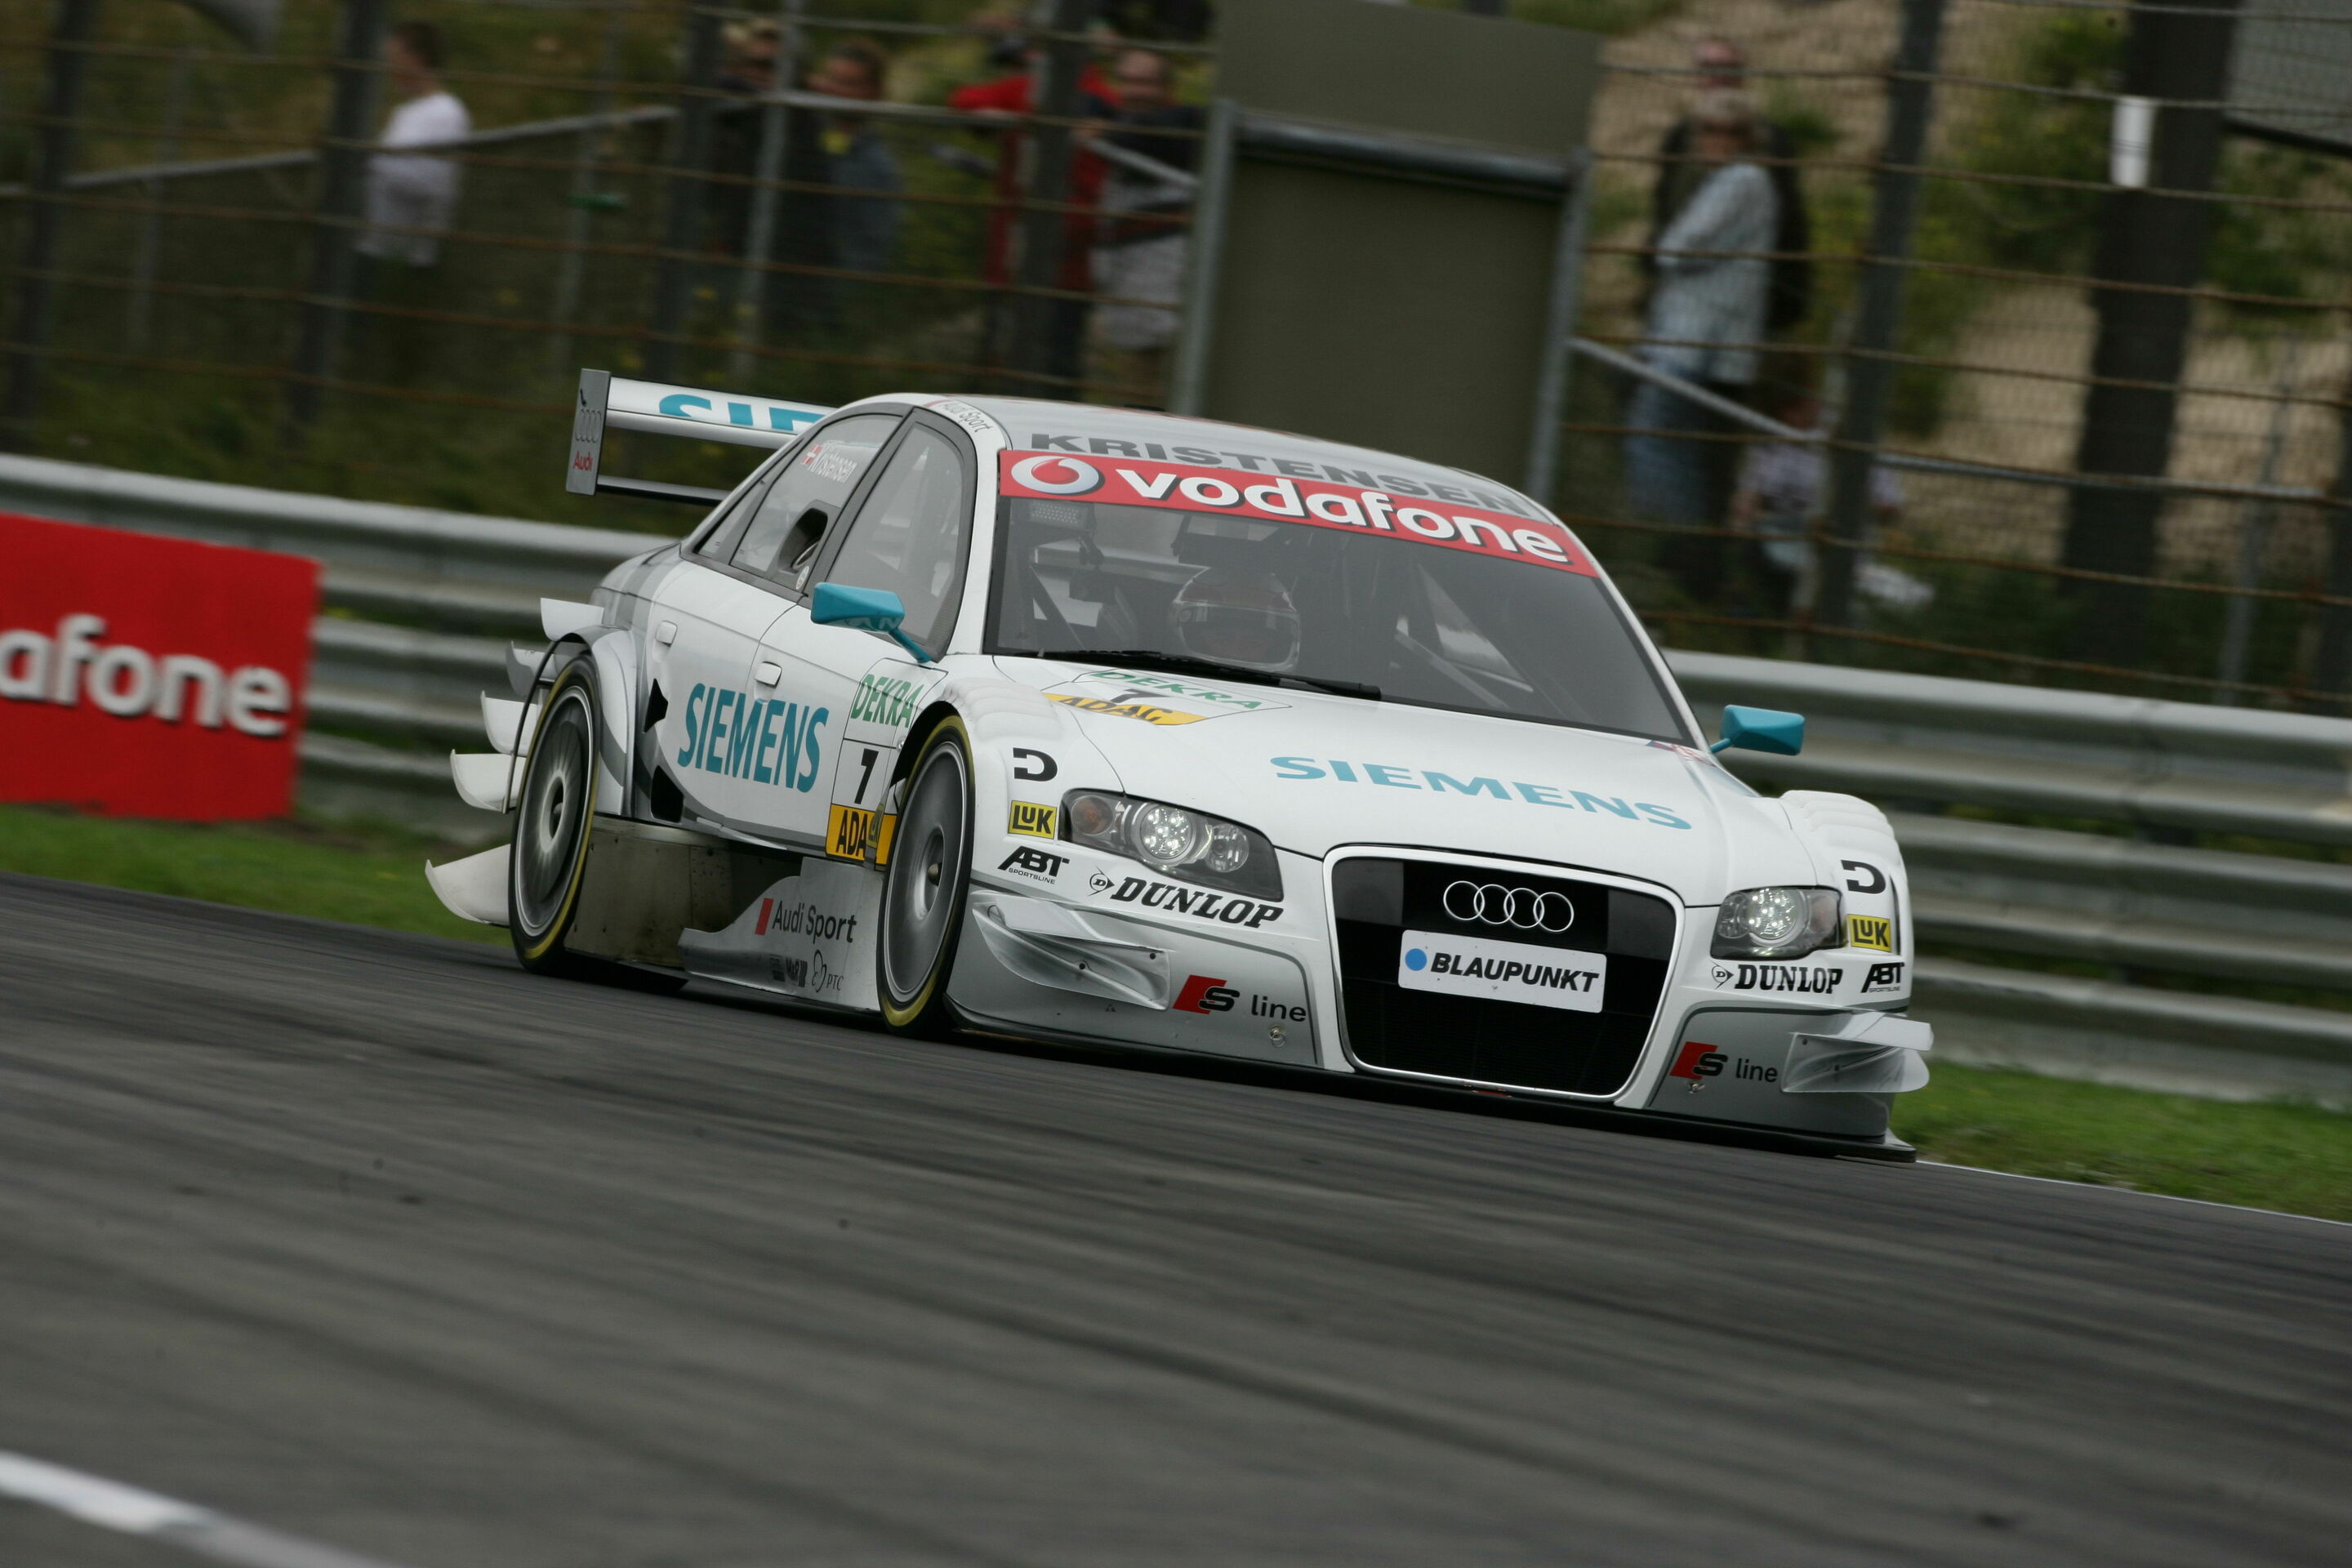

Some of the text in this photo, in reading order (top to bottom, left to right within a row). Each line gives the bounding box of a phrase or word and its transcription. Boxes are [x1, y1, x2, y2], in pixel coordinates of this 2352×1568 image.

[958, 411, 993, 433] Sport
[572, 450, 593, 471] Audi
[1031, 434, 1532, 517] KRISTENSEN
[1116, 468, 1571, 564] vodafone
[0, 613, 292, 737] afone
[1092, 671, 1263, 710] DEKRA
[850, 674, 924, 728] DEKRA
[1059, 697, 1173, 723] ADAC
[1111, 688, 1169, 704] 7
[677, 683, 830, 793] SIEMENS
[854, 748, 879, 805] 7
[1270, 756, 1692, 830] SIEMENS
[835, 809, 869, 858] ADA
[997, 845, 1070, 877] ABT
[1008, 867, 1056, 885] SPORTSLINE
[1110, 876, 1285, 929] DUNLOP
[772, 901, 858, 944] Audi Sport
[826, 973, 844, 991] PTC
[1430, 952, 1600, 994] BLAUPUNKT
[1735, 964, 1843, 994] DUNLOP
[1860, 962, 1905, 993] ABT
[1251, 995, 1307, 1022] line
[1735, 1058, 1778, 1082] line
